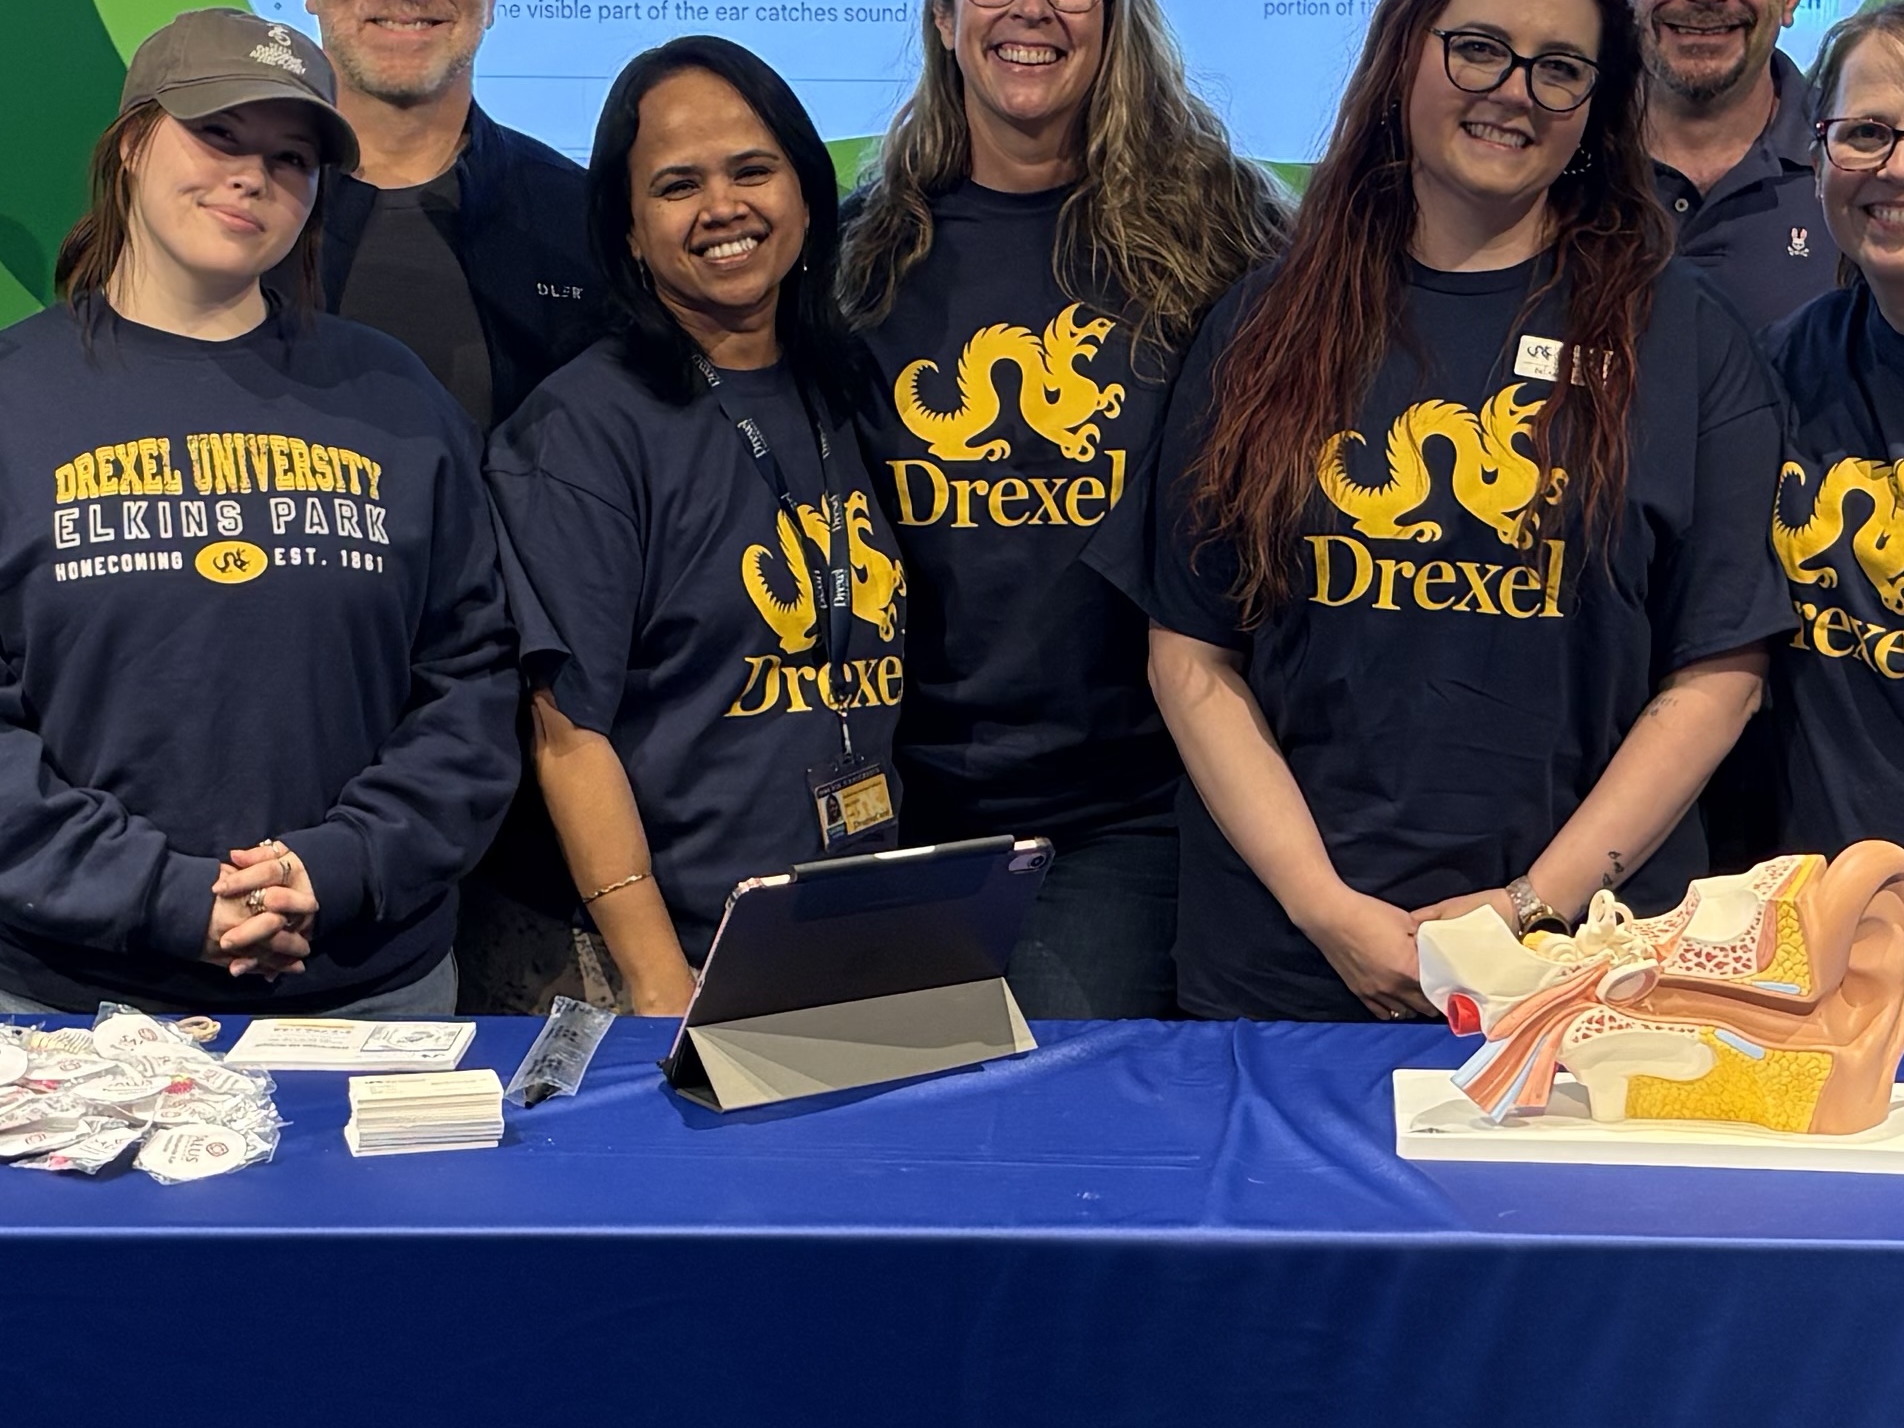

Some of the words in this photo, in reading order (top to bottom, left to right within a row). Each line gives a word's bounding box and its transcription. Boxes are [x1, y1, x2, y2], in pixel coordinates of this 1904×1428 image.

[527, 1, 592, 20] visible
[755, 3, 838, 22] catches
[844, 4, 907, 23] sound
[55, 438, 182, 504] DREXEL
[187, 433, 382, 500] UNIVERSITY
[885, 449, 1127, 528] Drexel
[54, 500, 243, 549] ELKINS
[269, 497, 390, 544] PARK
[55, 552, 183, 582] HOMECOMING
[275, 548, 327, 566] EST.
[1304, 531, 1565, 620] Drexel
